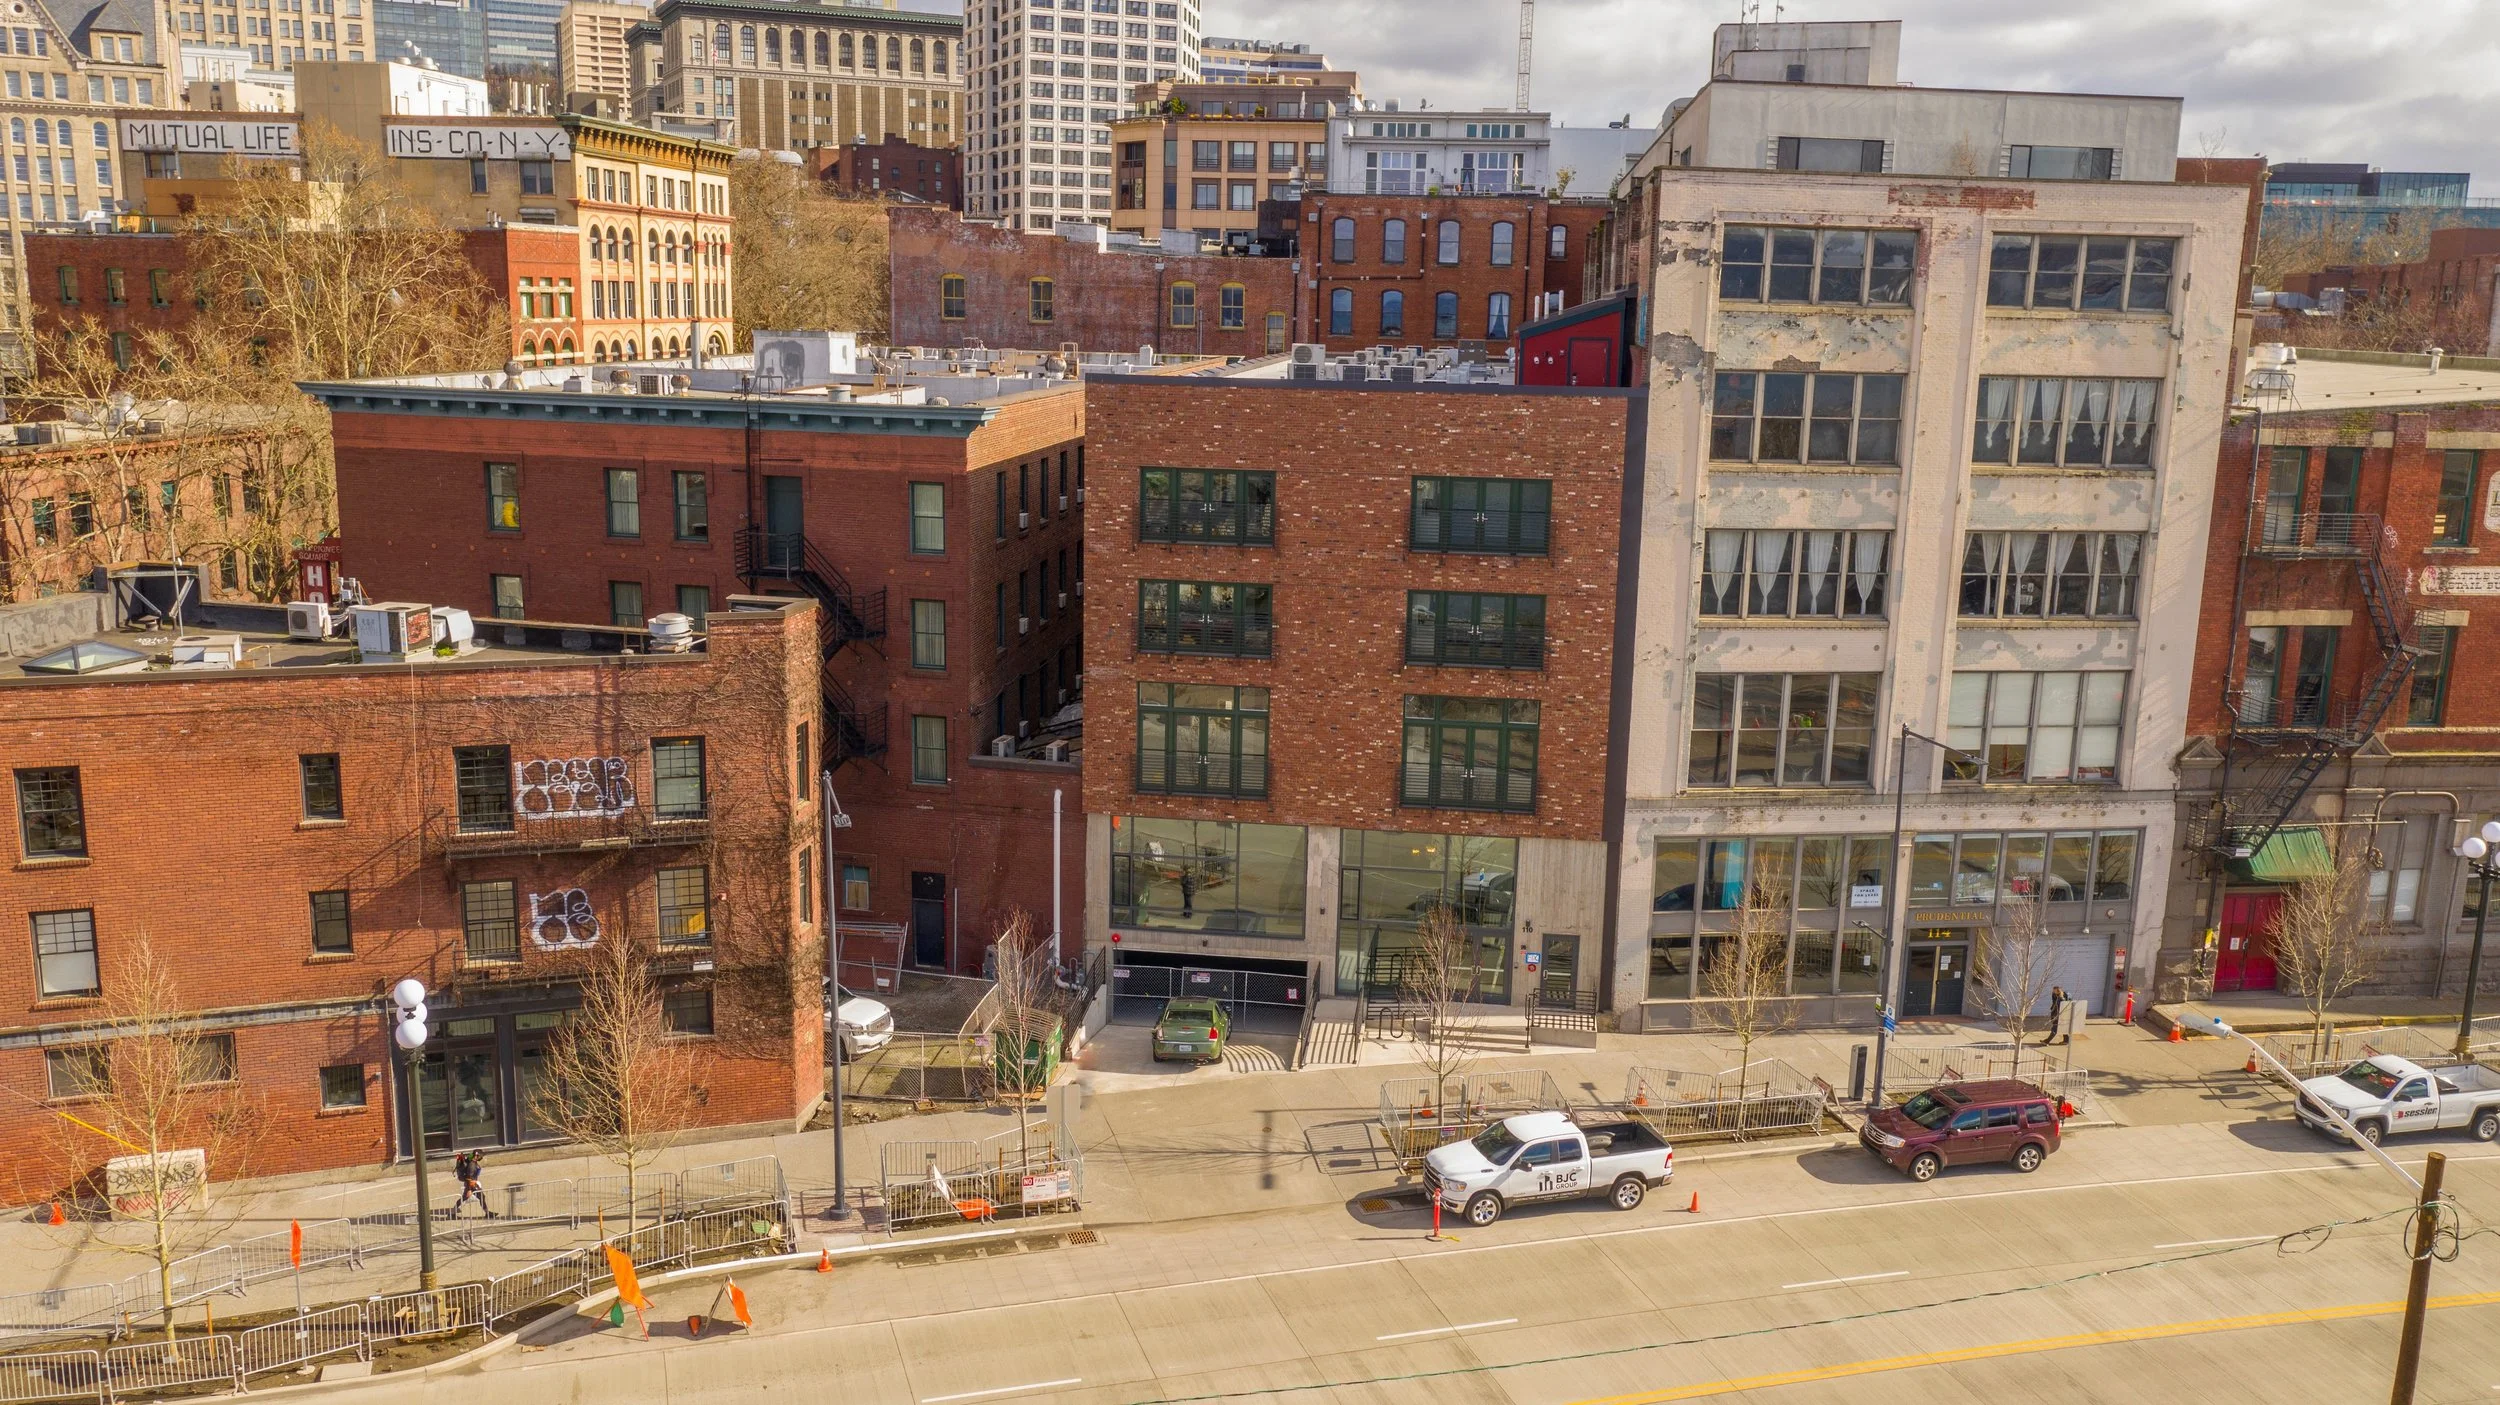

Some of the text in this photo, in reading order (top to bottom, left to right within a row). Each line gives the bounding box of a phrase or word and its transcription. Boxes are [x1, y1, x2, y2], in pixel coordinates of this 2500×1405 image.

[129, 123, 291, 150] MUTUAL LIFE
[313, 545, 342, 554] PIONEE
[298, 551, 329, 560] SQUARE
[1916, 911, 1985, 921] PRUDENTIAL
[1928, 928, 1952, 938] 114
[1023, 1178, 1033, 1186] NO
[1556, 1172, 1577, 1183] BJC
